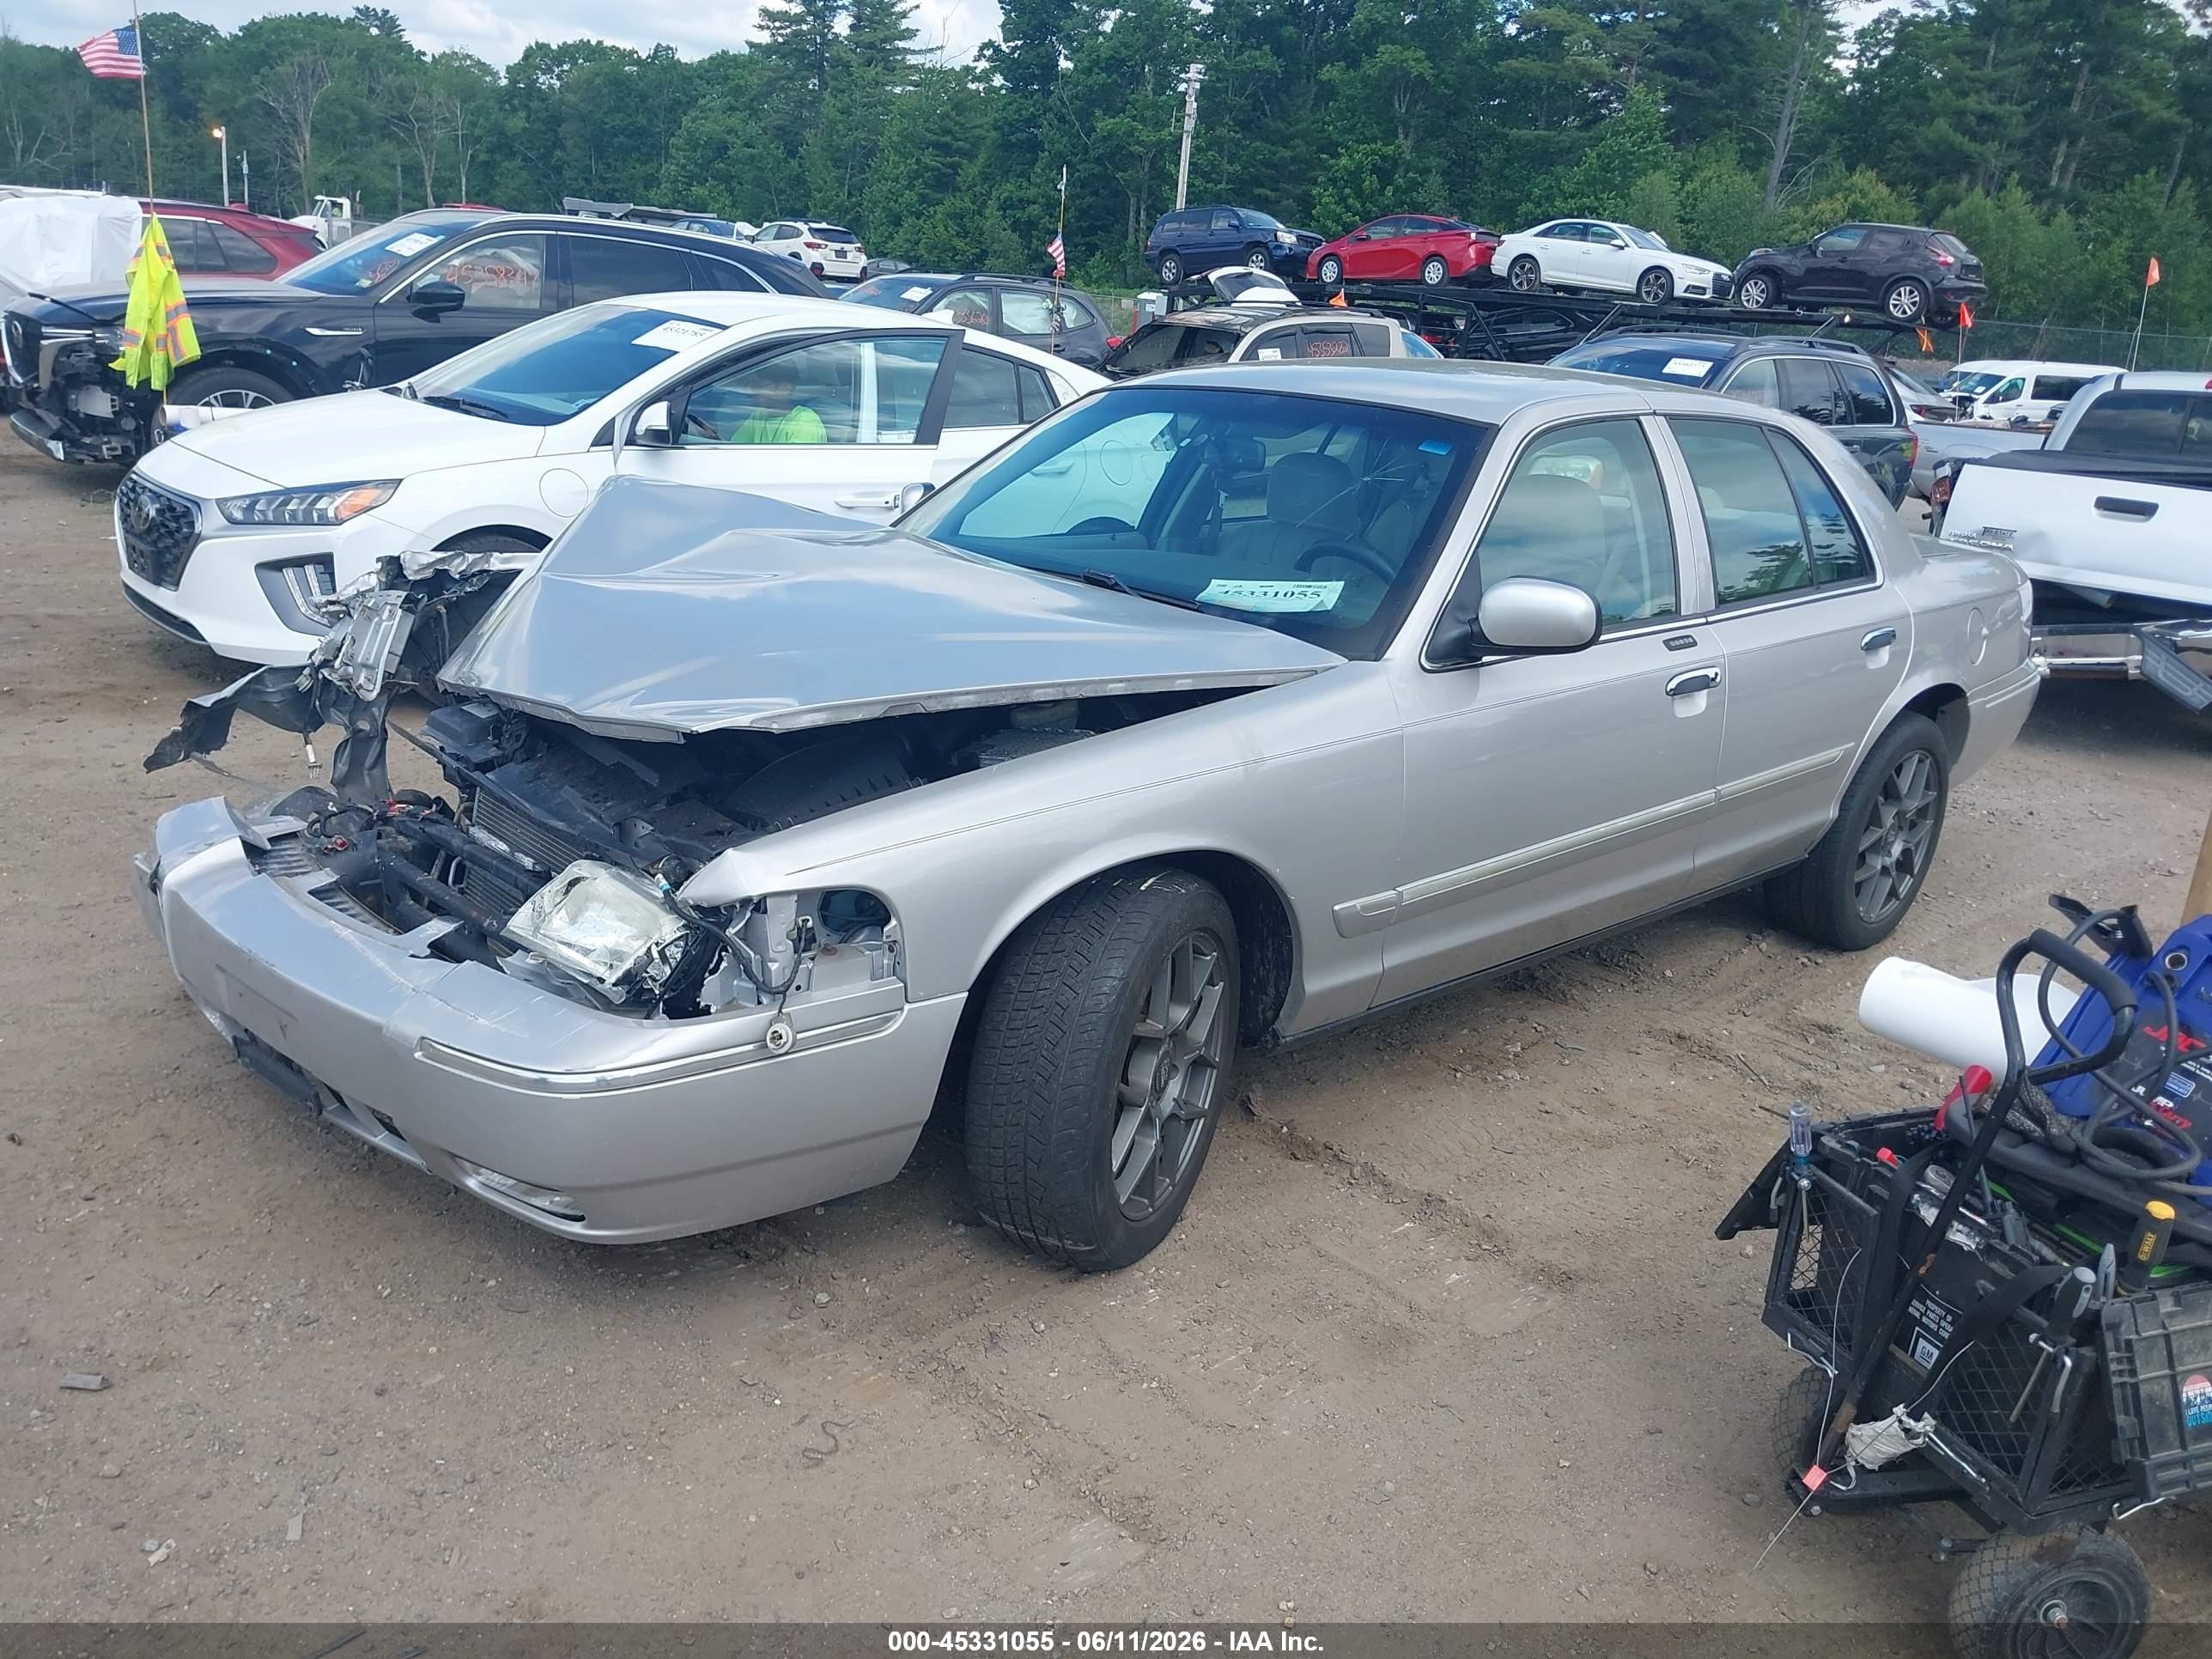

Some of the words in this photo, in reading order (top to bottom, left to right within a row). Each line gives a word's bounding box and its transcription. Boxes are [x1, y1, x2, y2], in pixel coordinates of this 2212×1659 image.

[1948, 529, 1978, 539] TOYOTA
[1217, 589, 1322, 599] 45331055
[1925, 1298, 1947, 1318] PROPERTY
[1921, 1315, 1939, 1333] MOTORS
[1920, 1346, 1934, 1361] GM
